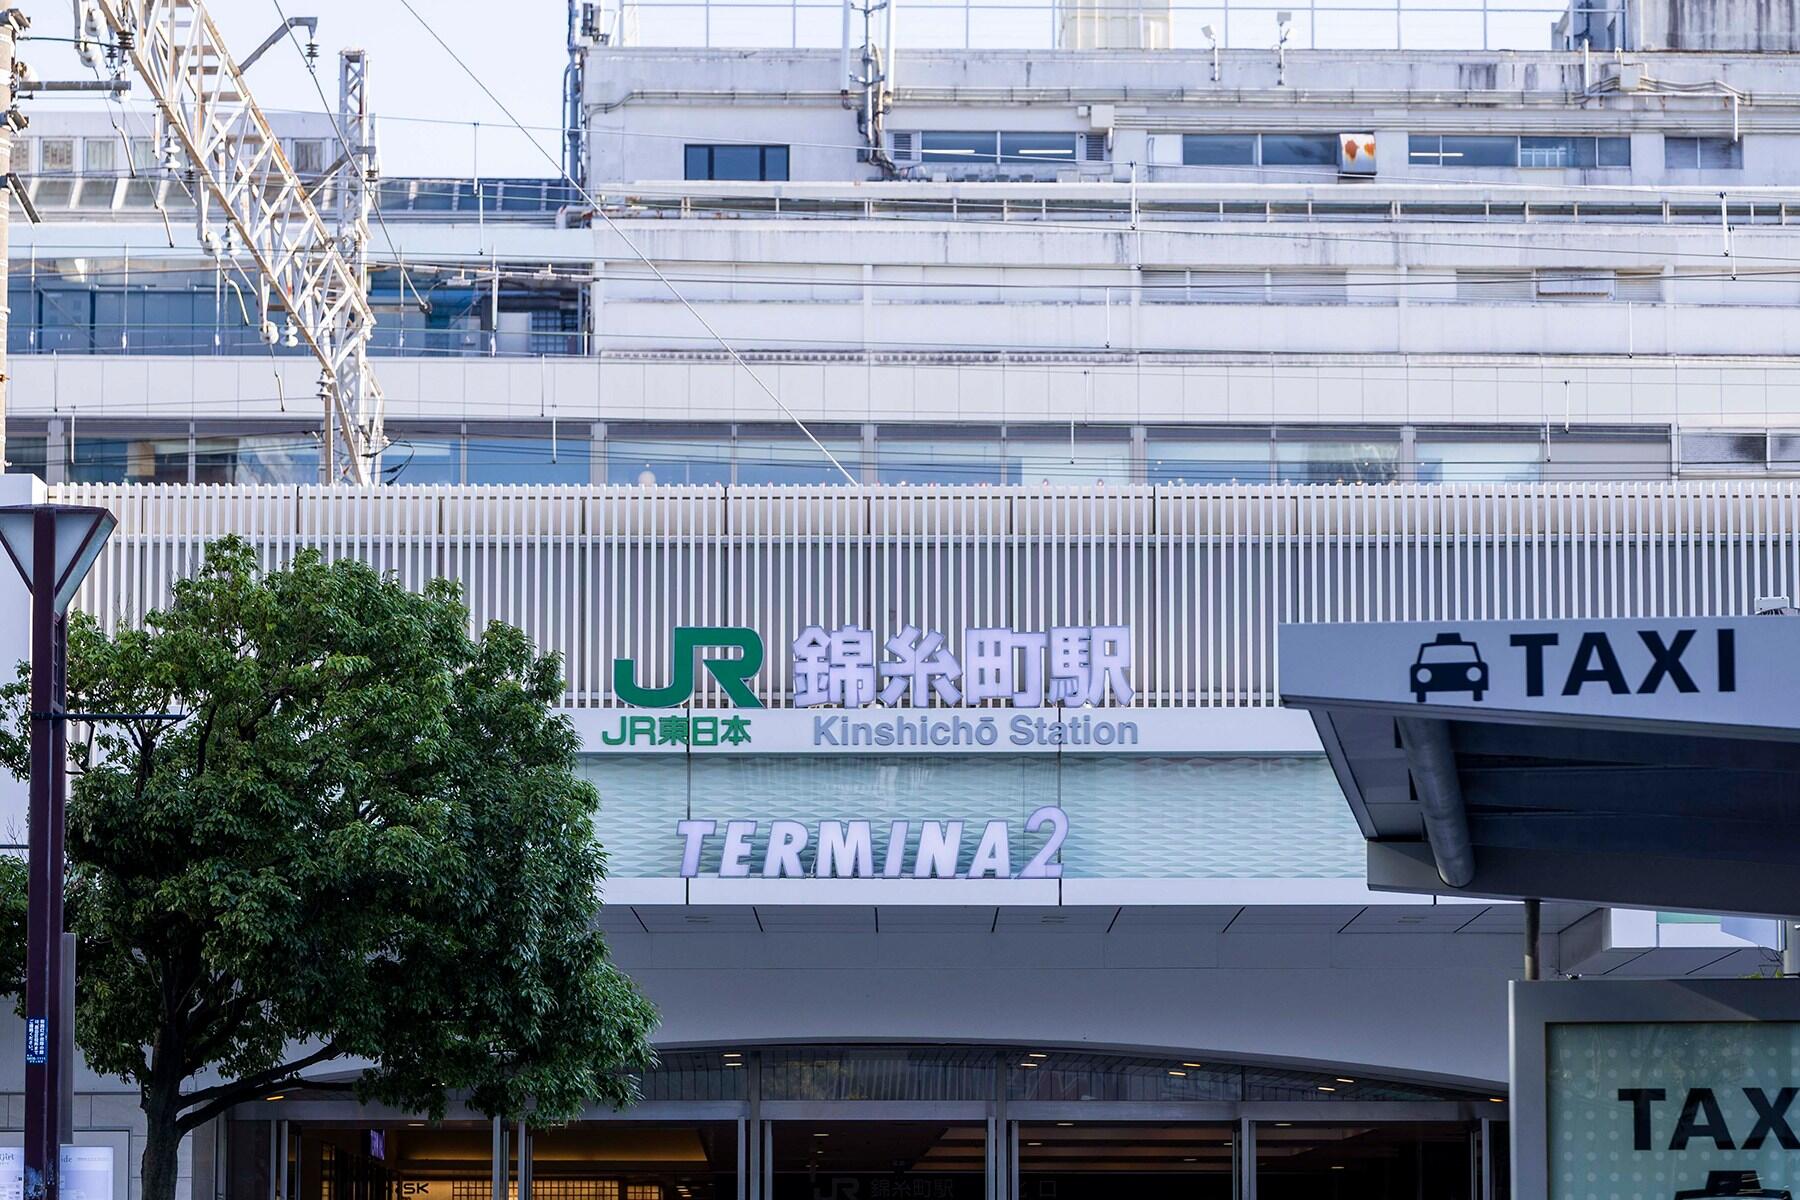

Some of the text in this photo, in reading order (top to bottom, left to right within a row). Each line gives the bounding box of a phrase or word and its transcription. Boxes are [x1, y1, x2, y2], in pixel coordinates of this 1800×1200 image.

[613, 627, 767, 709] JR
[792, 624, 1135, 709] 錦糸町駅
[1510, 628, 1736, 697] TAXI
[602, 715, 752, 746] JR東日本
[813, 715, 1139, 746] Kinshichō Station
[1618, 1087, 1800, 1151] TAX
